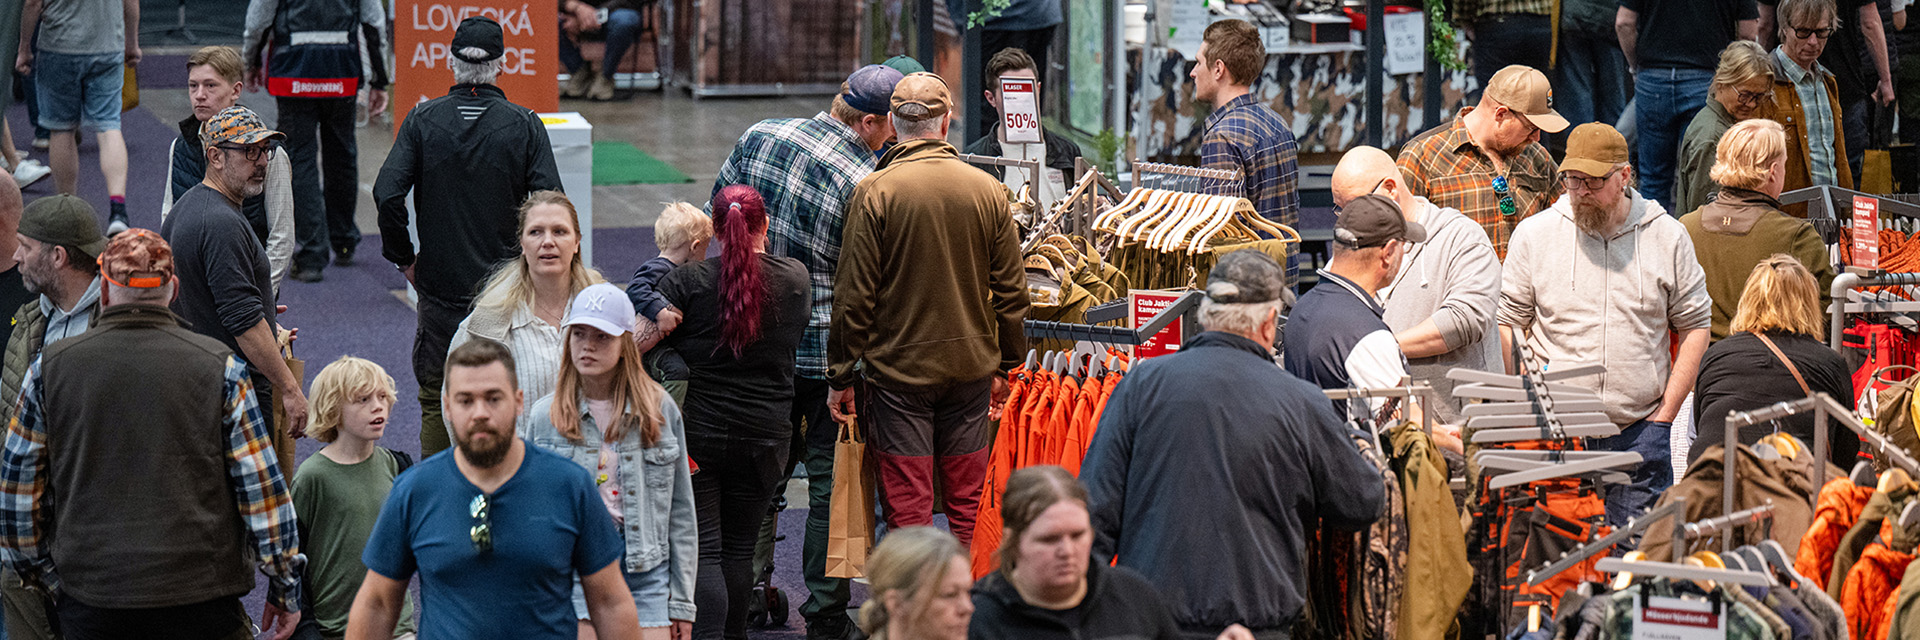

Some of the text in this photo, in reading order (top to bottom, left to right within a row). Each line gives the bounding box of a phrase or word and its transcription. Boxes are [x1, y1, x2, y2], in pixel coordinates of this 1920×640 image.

[411, 42, 536, 76] APCE
[1006, 113, 1037, 128] 50%
[1138, 306, 1166, 314] kampan
